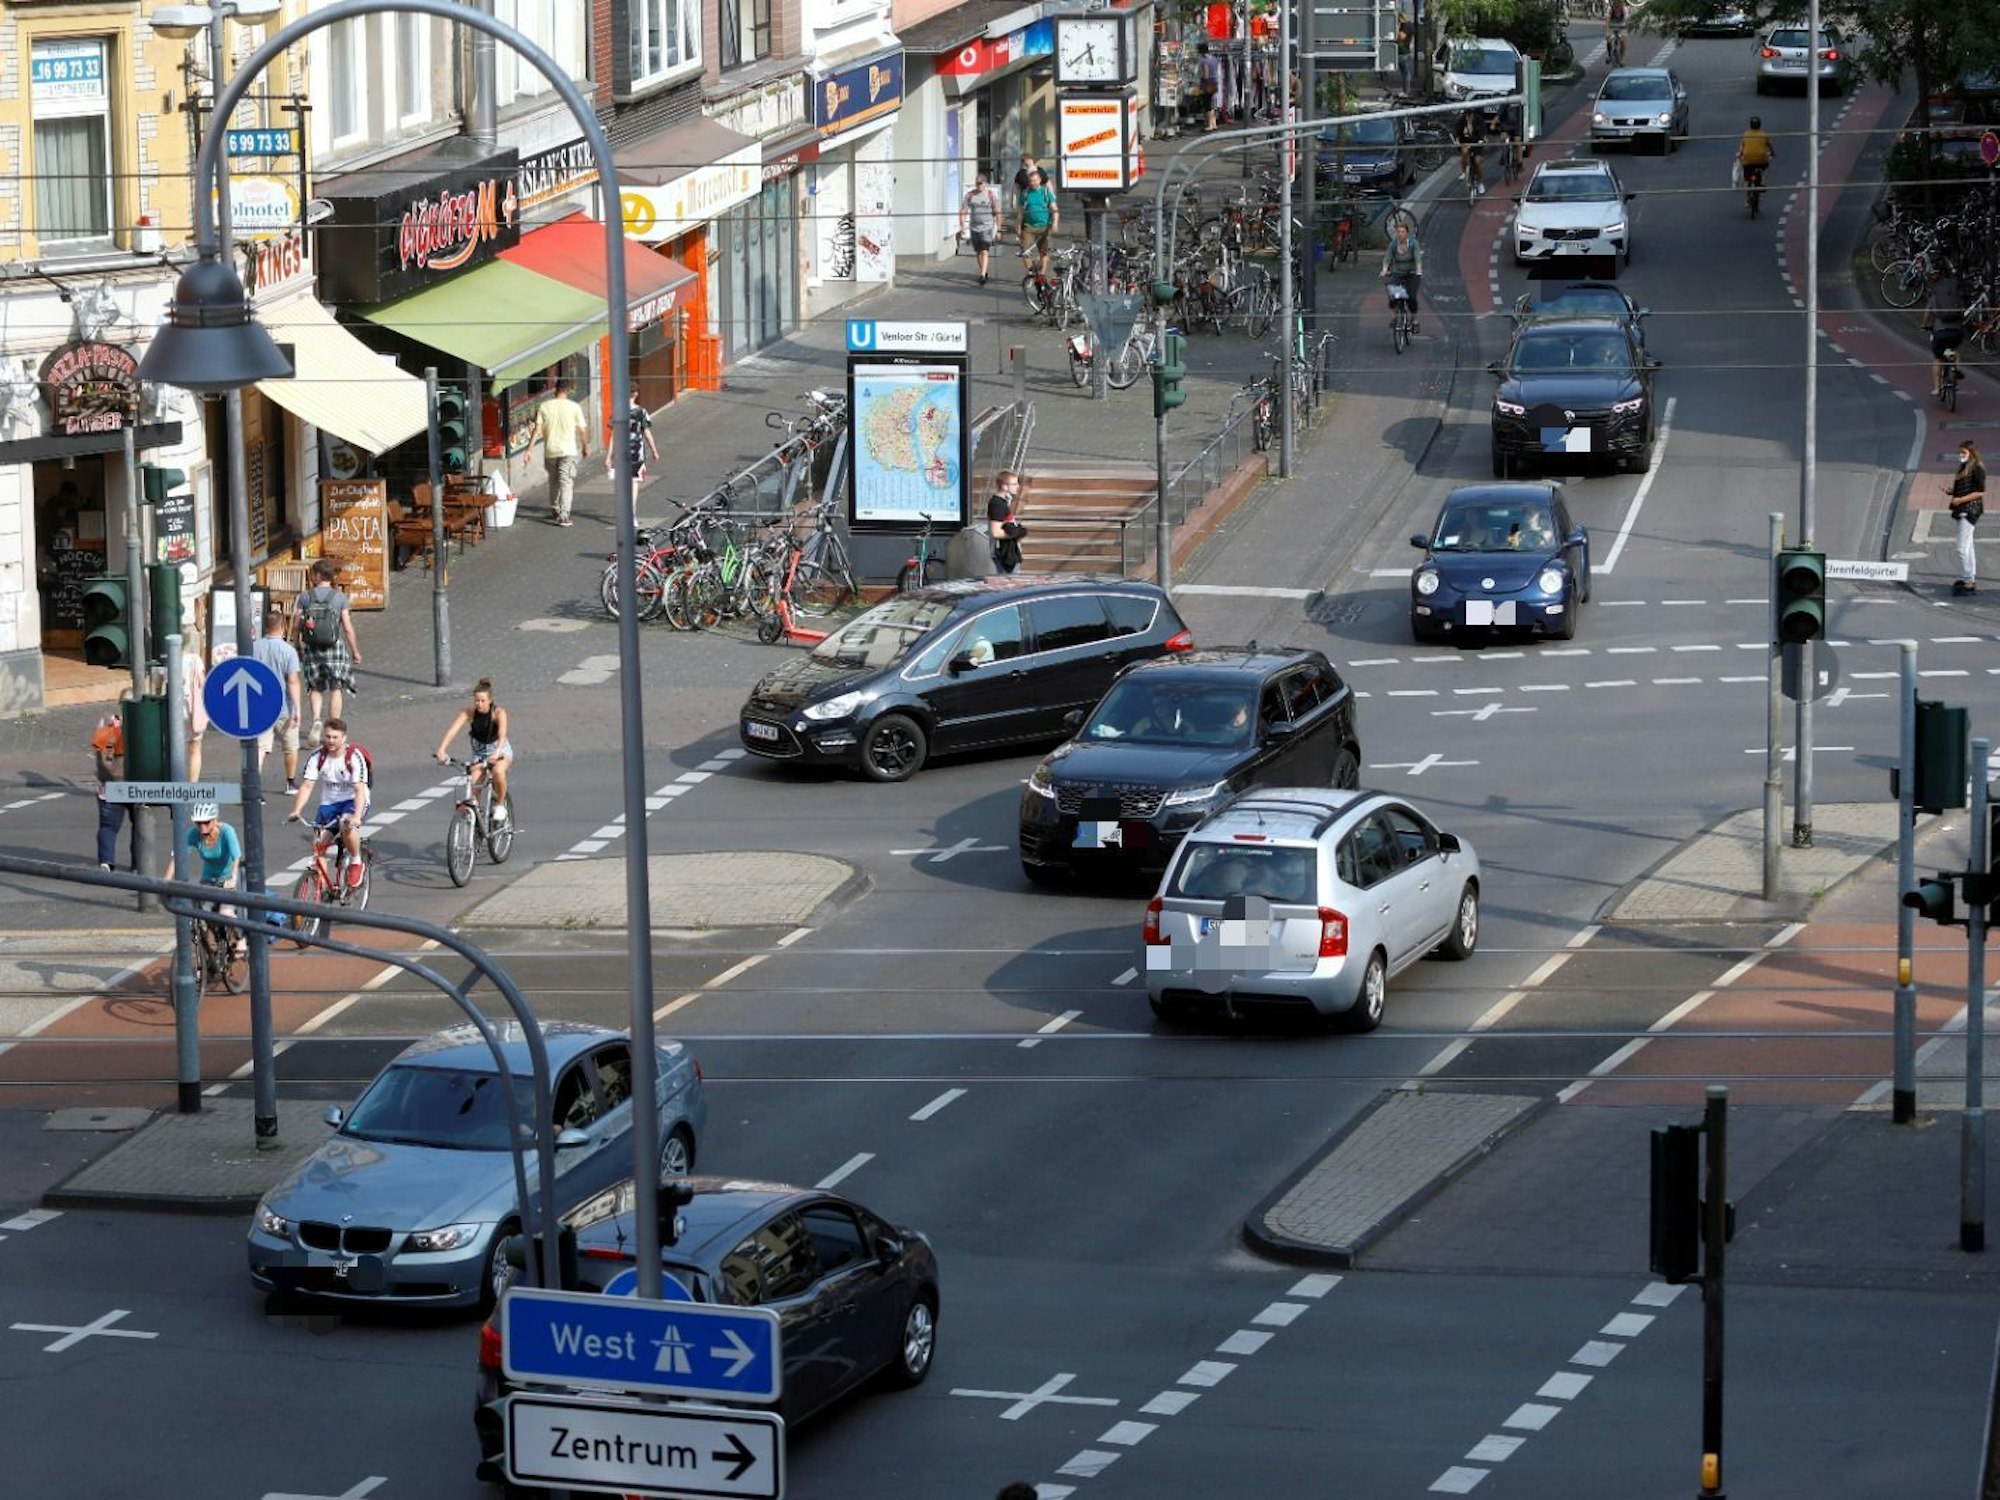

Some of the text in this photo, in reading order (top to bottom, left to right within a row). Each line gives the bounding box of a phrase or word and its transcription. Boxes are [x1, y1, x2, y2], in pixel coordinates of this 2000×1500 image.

[53, 60, 68, 79] 99
[69, 59, 84, 78] 73
[85, 57, 100, 77] 33
[228, 133, 290, 151] 6 99 73 33
[257, 236, 301, 289] KINGS
[851, 322, 872, 347] U
[881, 331, 913, 342] Venloer
[328, 516, 382, 541] PASTA
[127, 785, 216, 801] Ehrenfeldgürtel
[550, 1322, 637, 1361] West
[550, 1427, 698, 1470] Zentrum
